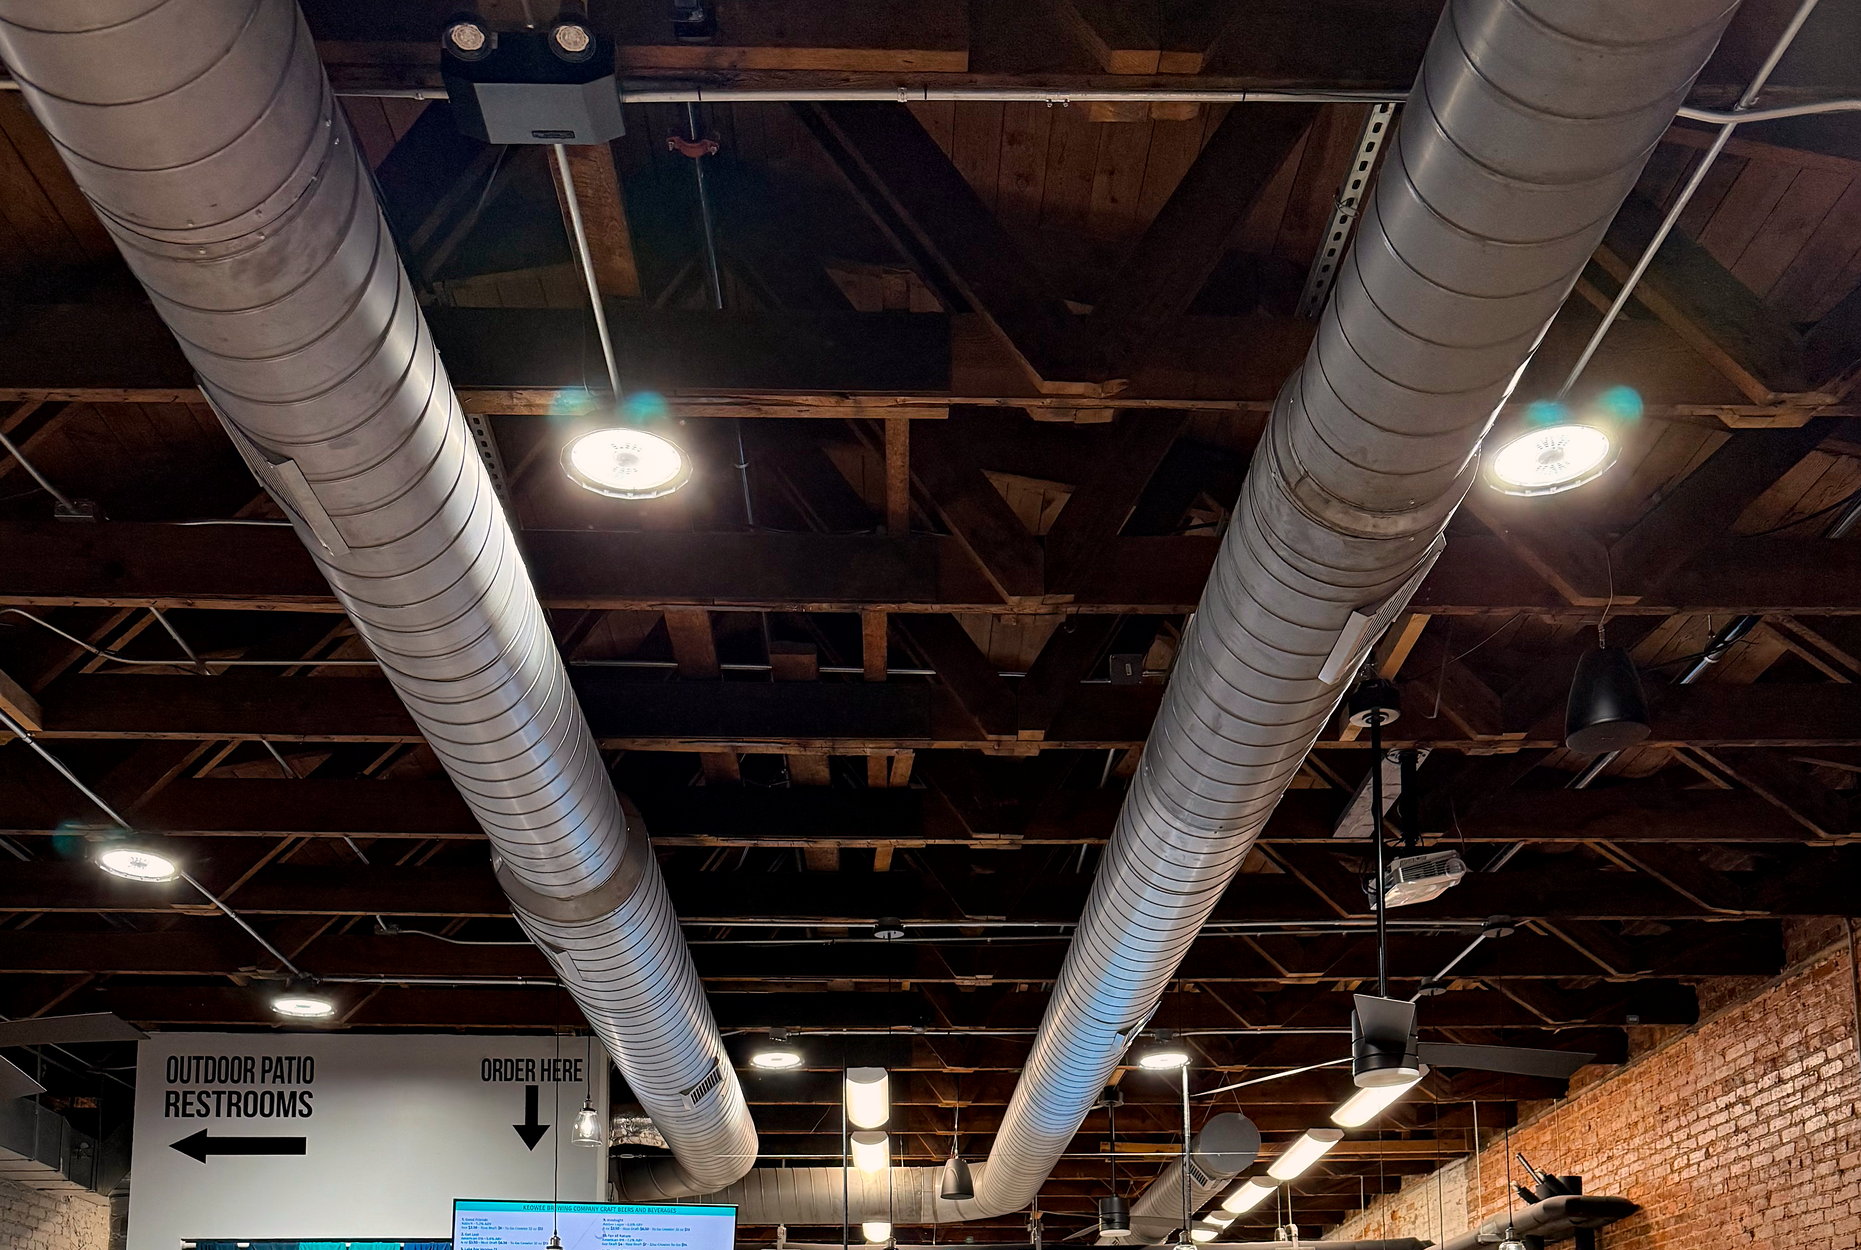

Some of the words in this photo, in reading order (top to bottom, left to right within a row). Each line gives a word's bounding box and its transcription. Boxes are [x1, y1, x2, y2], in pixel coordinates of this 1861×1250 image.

[166, 1055, 256, 1084] OUTDOOR
[260, 1055, 315, 1084] PATIO
[481, 1058, 536, 1082] ORDER
[540, 1058, 583, 1082] HERE
[163, 1090, 314, 1119] RESTROOMS
[522, 1204, 546, 1212] KEOWEE
[573, 1205, 599, 1213] COMPANY
[648, 1207, 677, 1215] BEVERAGES
